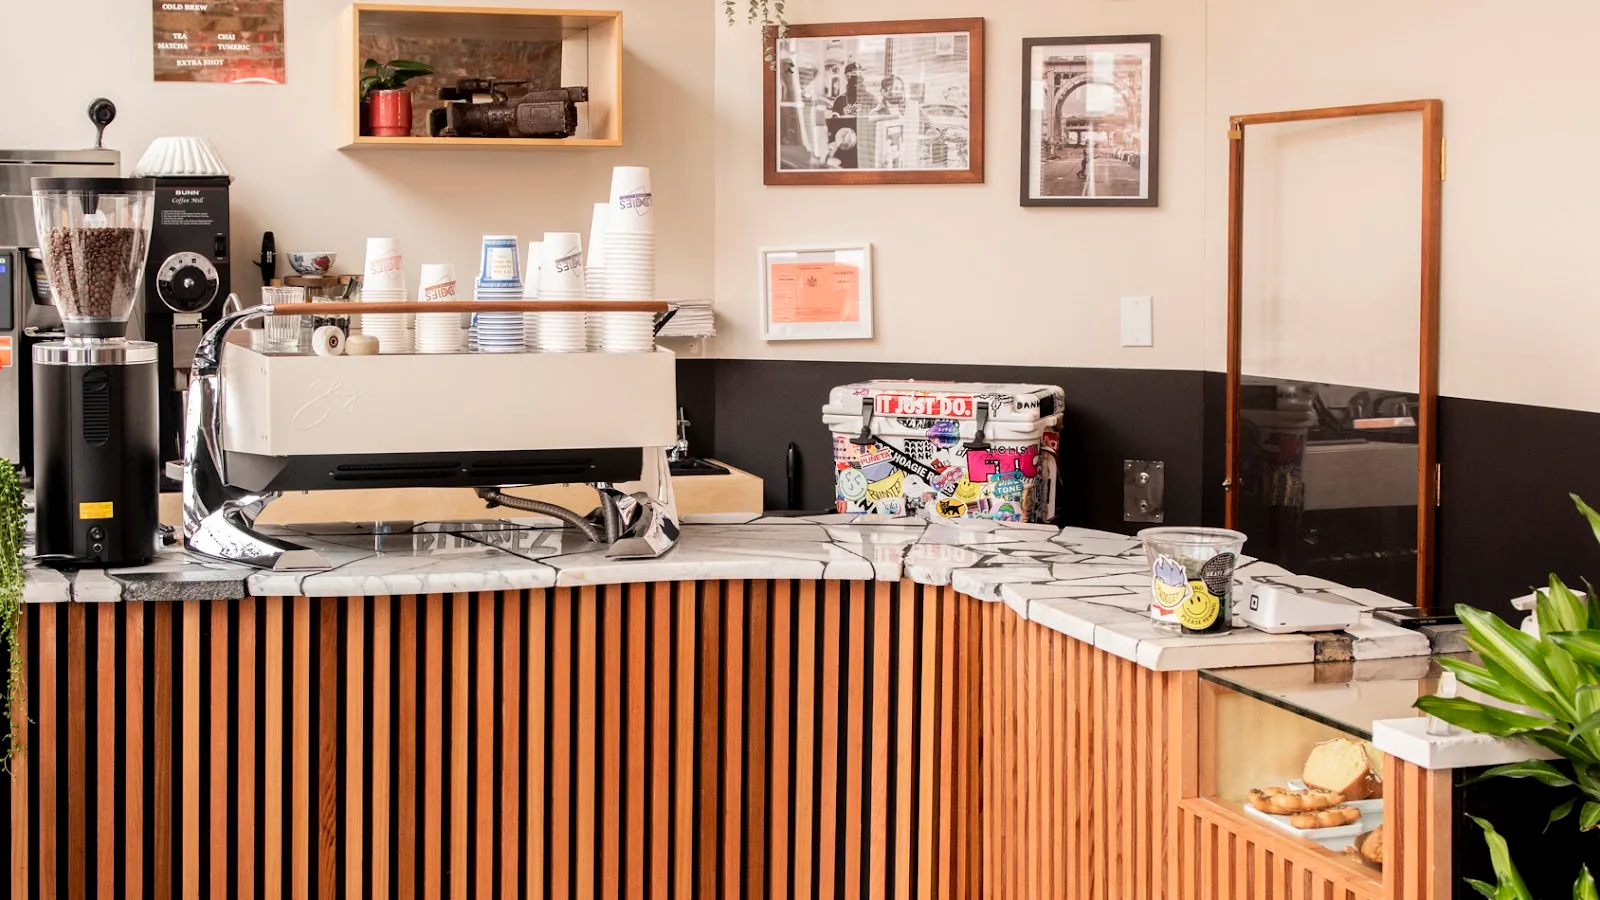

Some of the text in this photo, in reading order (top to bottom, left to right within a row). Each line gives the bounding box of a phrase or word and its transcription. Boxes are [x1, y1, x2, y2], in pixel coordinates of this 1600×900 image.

[162, 3, 208, 11] COLD BREW
[217, 33, 236, 41] CHAI
[171, 197, 190, 205] Coffee
[876, 395, 971, 417] IT JUST DO.
[893, 452, 928, 478] HOAGIE
[998, 478, 1019, 486] DIAL
[997, 485, 1022, 494] TONE
[1181, 602, 1217, 625] PLEASE REWIND
